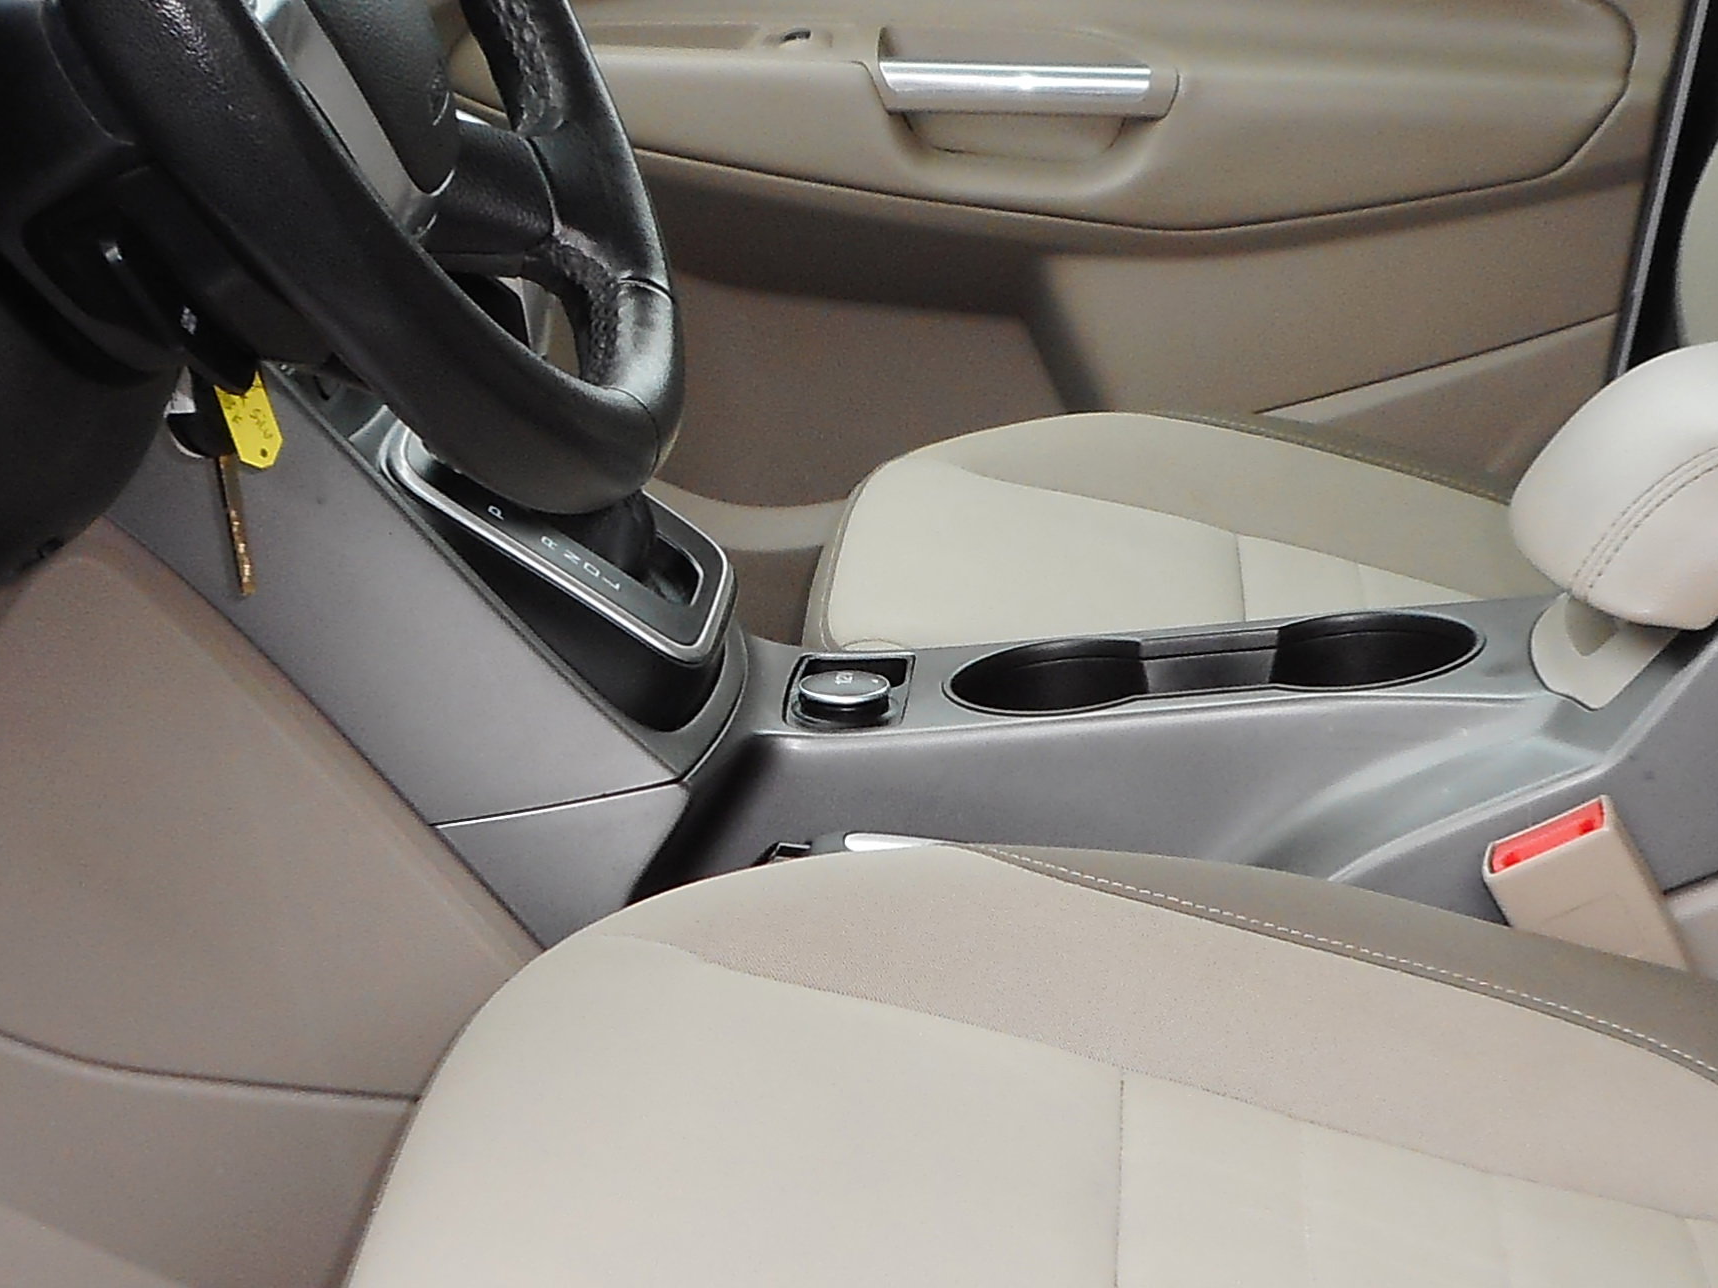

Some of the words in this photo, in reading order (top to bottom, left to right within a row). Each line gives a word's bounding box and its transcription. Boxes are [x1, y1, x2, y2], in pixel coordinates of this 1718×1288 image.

[488, 505, 504, 520] P
[541, 536, 558, 550] R
[563, 549, 581, 565] N
[584, 562, 600, 578] D
[602, 577, 621, 591] L
